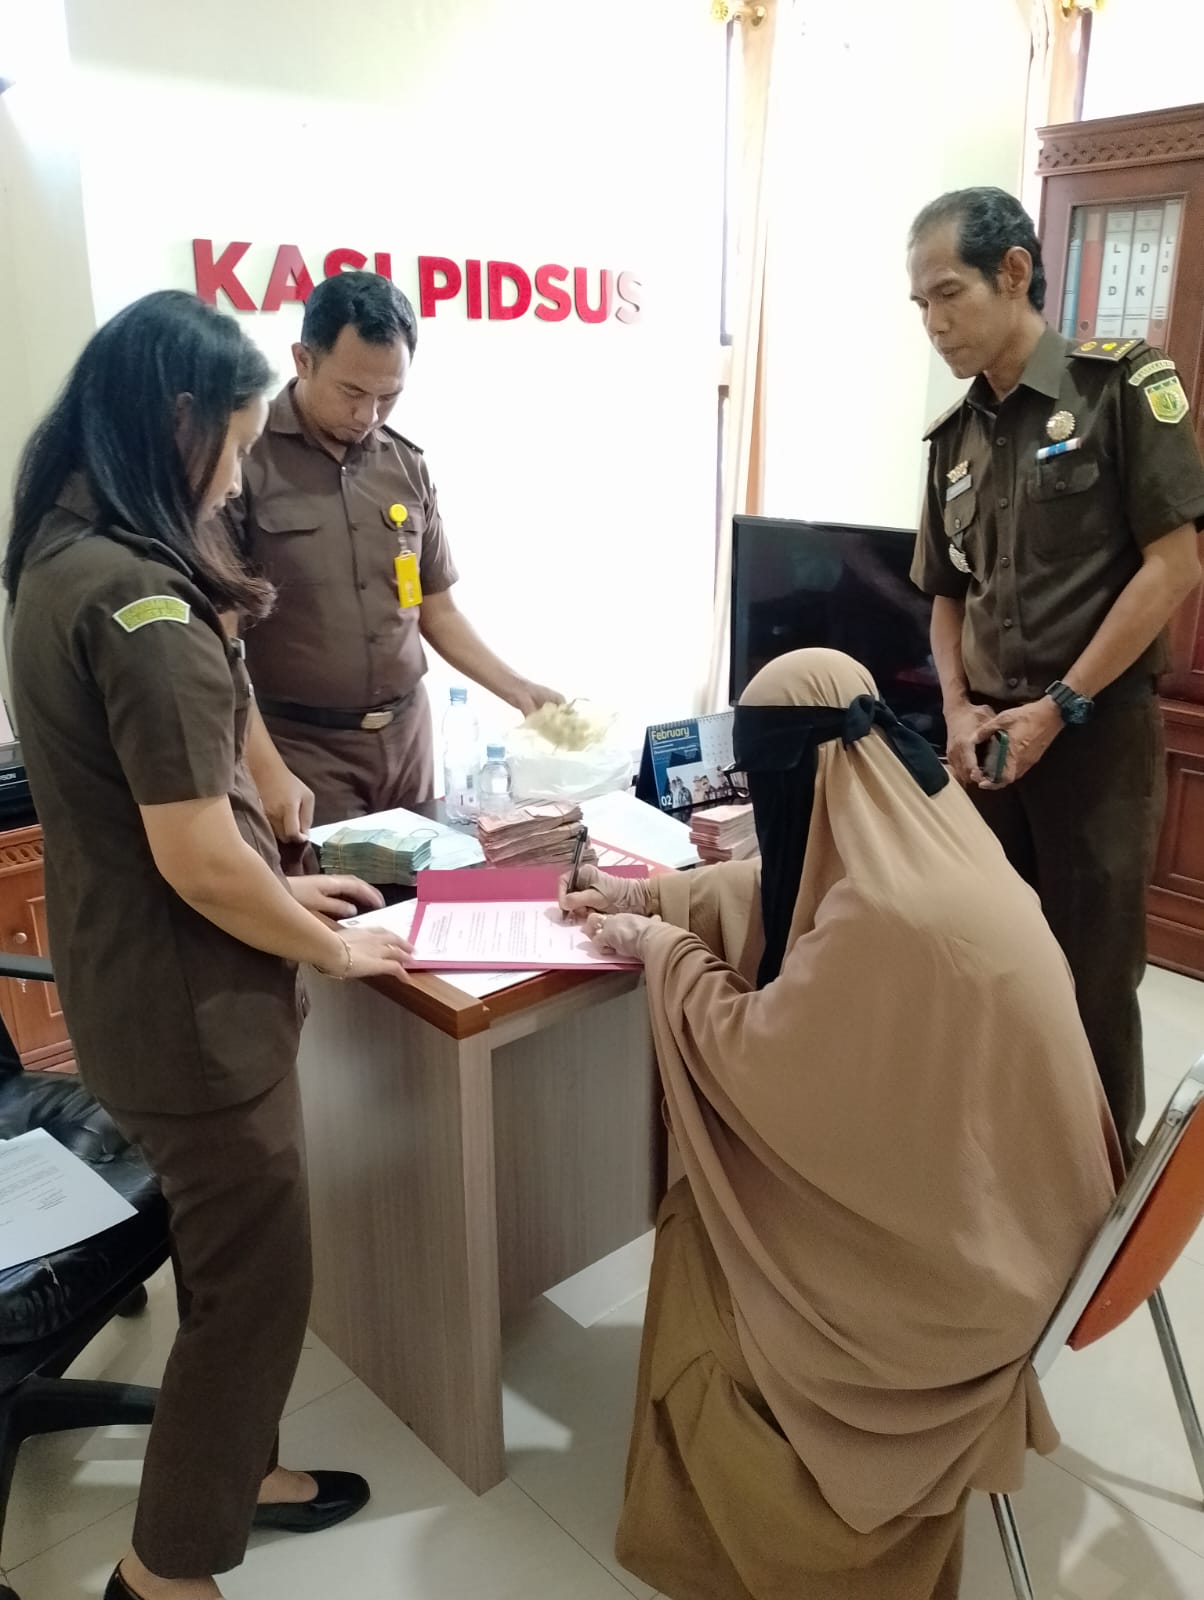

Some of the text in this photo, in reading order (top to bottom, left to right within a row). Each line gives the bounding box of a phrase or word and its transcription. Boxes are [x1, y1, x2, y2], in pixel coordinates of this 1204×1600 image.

[418, 256, 643, 324] PIDSUS
[1108, 243, 1121, 296] LID
[1135, 243, 1150, 296] DIK
[651, 727, 689, 741] February
[661, 795, 672, 806] 02
